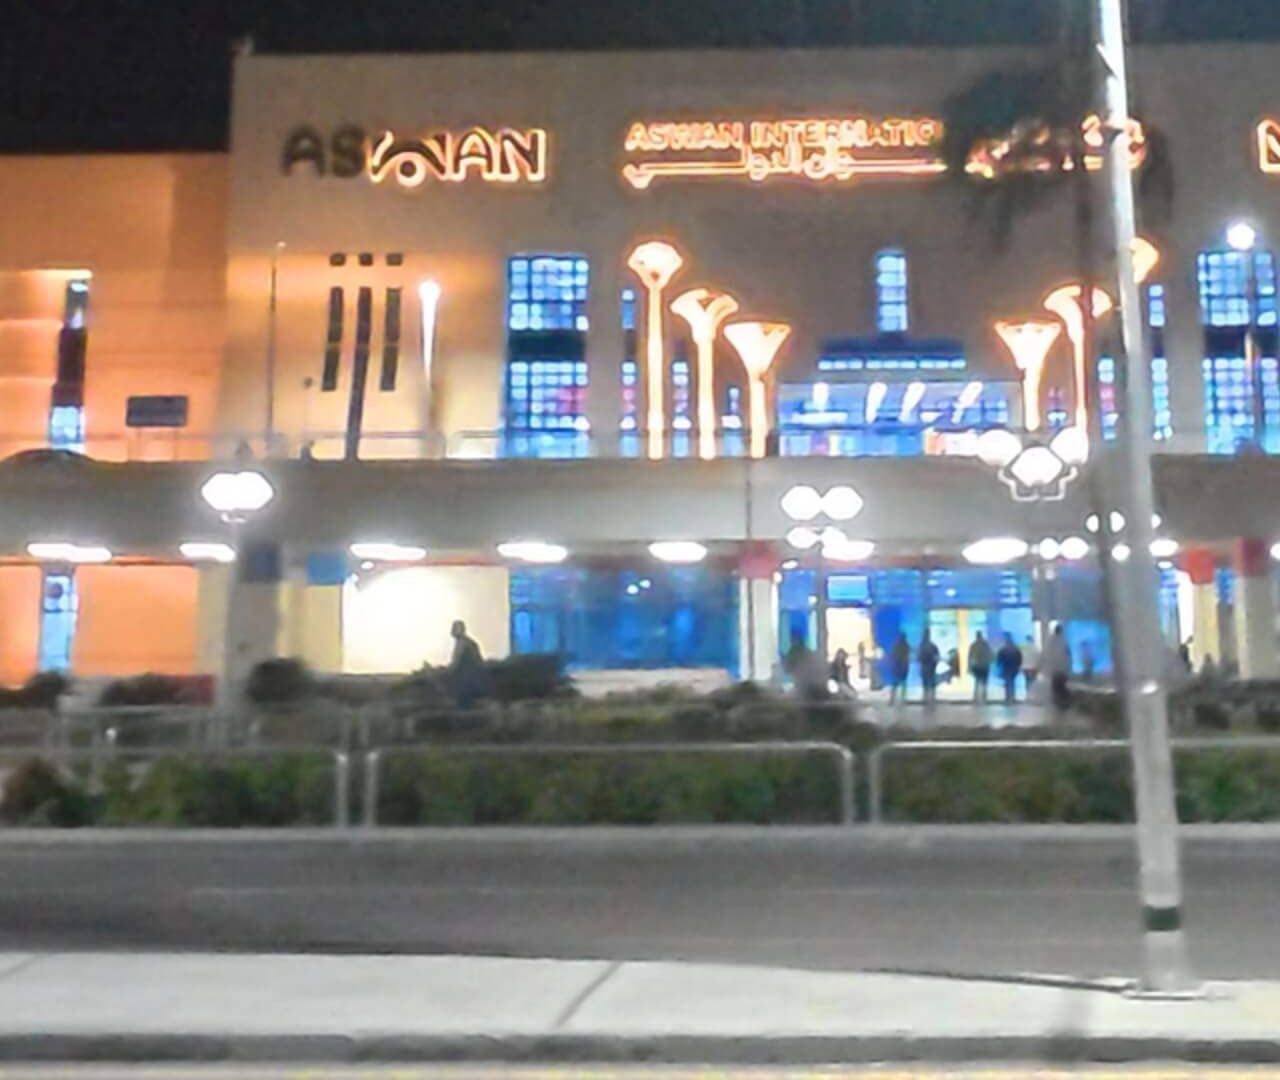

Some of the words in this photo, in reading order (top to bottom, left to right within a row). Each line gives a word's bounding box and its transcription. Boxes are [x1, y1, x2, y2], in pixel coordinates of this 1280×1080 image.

[282, 124, 547, 188] ASWAN
[624, 121, 743, 150] ASWAN
[749, 118, 945, 147] INTERNATIO
